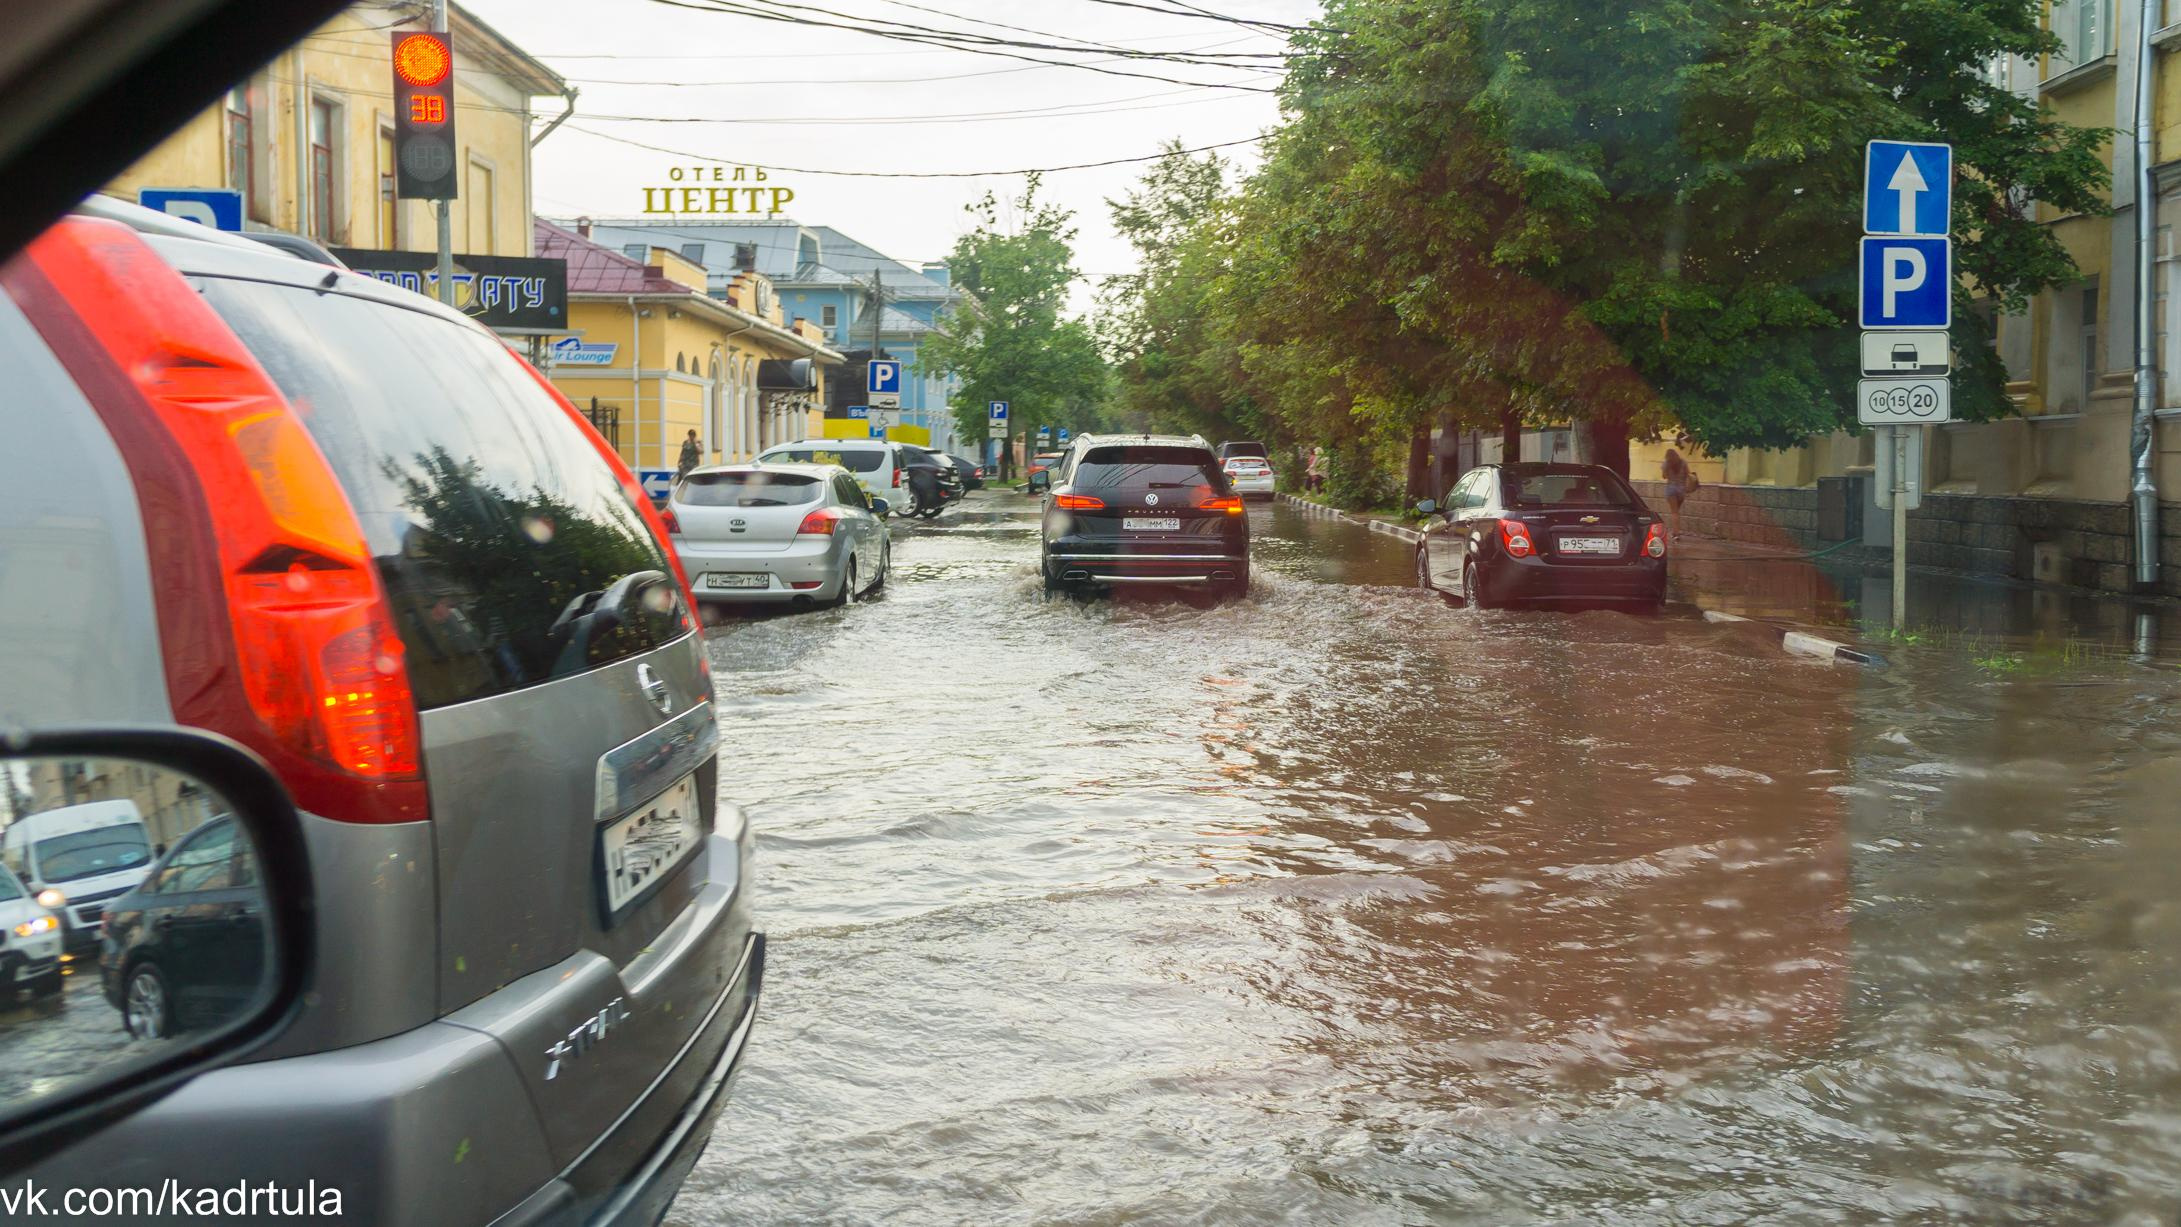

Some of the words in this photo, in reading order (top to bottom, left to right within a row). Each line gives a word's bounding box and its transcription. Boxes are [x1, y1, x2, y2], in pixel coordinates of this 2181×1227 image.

[411, 94, 445, 123] 38
[669, 167, 767, 181] ОТЕЛЬ
[642, 187, 794, 214] ЦЕНТР
[1882, 247, 1927, 318] P
[565, 351, 612, 364] Lounge
[875, 364, 893, 390] P
[993, 403, 1004, 417] P
[1873, 397, 1885, 407] 10
[1890, 395, 1906, 407] 15
[1913, 394, 1933, 408] 20
